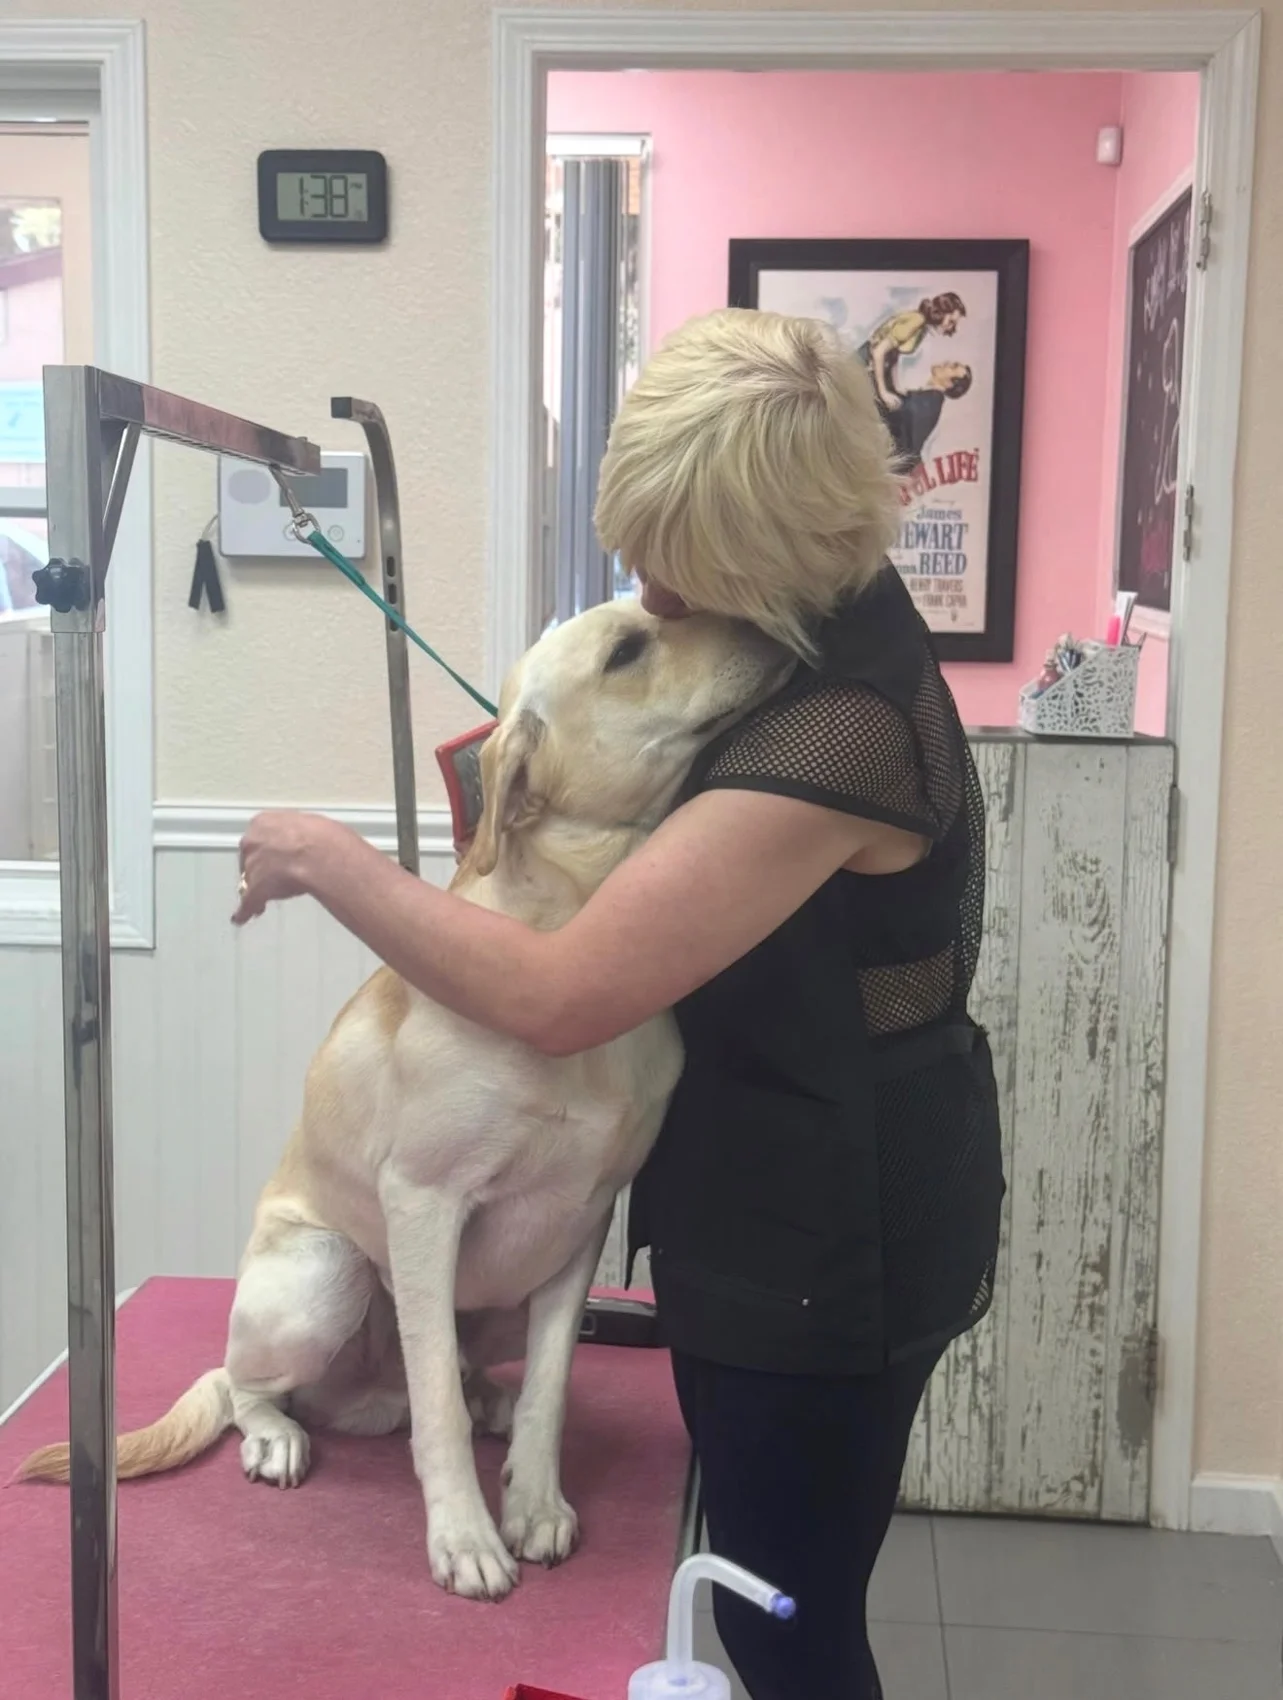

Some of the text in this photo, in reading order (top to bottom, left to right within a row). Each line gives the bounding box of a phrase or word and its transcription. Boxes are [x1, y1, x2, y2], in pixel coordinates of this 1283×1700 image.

[299, 174, 349, 218] 1:38
[916, 506, 963, 520] James
[892, 521, 968, 550] TEWART
[919, 552, 968, 575] REED
